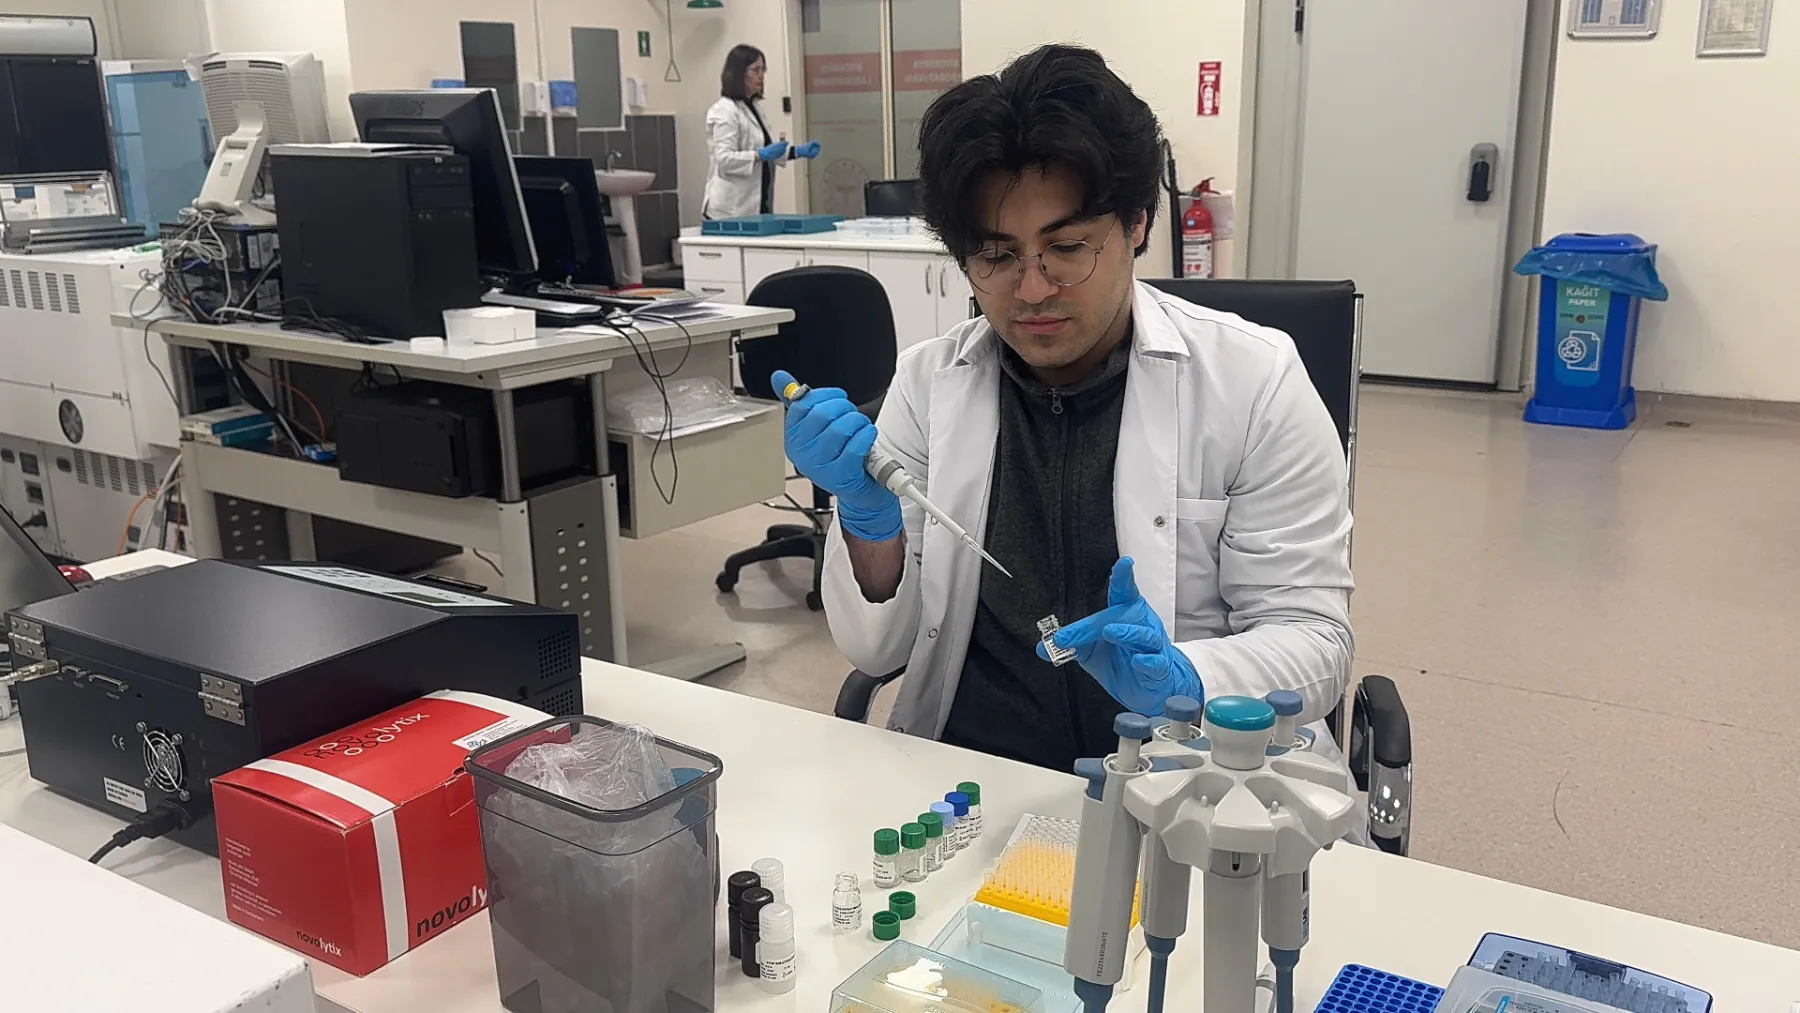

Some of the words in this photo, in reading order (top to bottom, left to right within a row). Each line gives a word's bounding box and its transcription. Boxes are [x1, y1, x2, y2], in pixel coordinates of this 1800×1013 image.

[1565, 284, 1600, 297] KAĞIT
[1568, 298, 1596, 307] PAPER
[416, 885, 488, 938] novoly
[296, 930, 342, 957] novolytix
